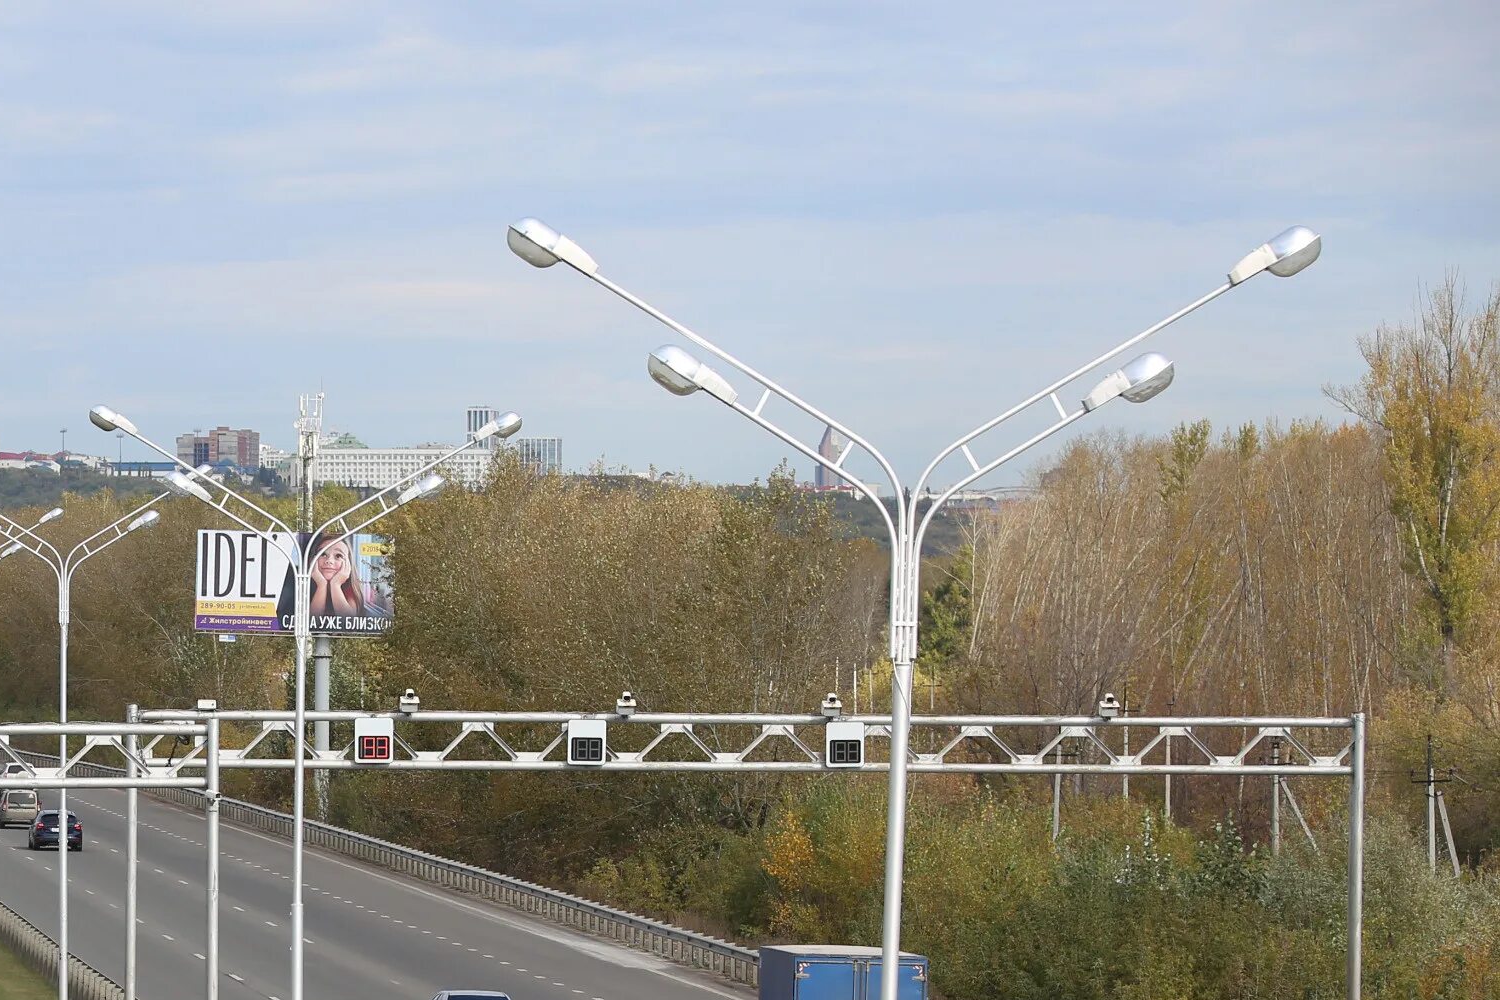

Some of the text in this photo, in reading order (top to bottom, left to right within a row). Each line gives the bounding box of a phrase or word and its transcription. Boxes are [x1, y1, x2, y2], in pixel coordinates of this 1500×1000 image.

[209, 618, 273, 626] Жилстройинвест
[282, 614, 318, 630] СДА
[319, 615, 343, 630] УЖЕ
